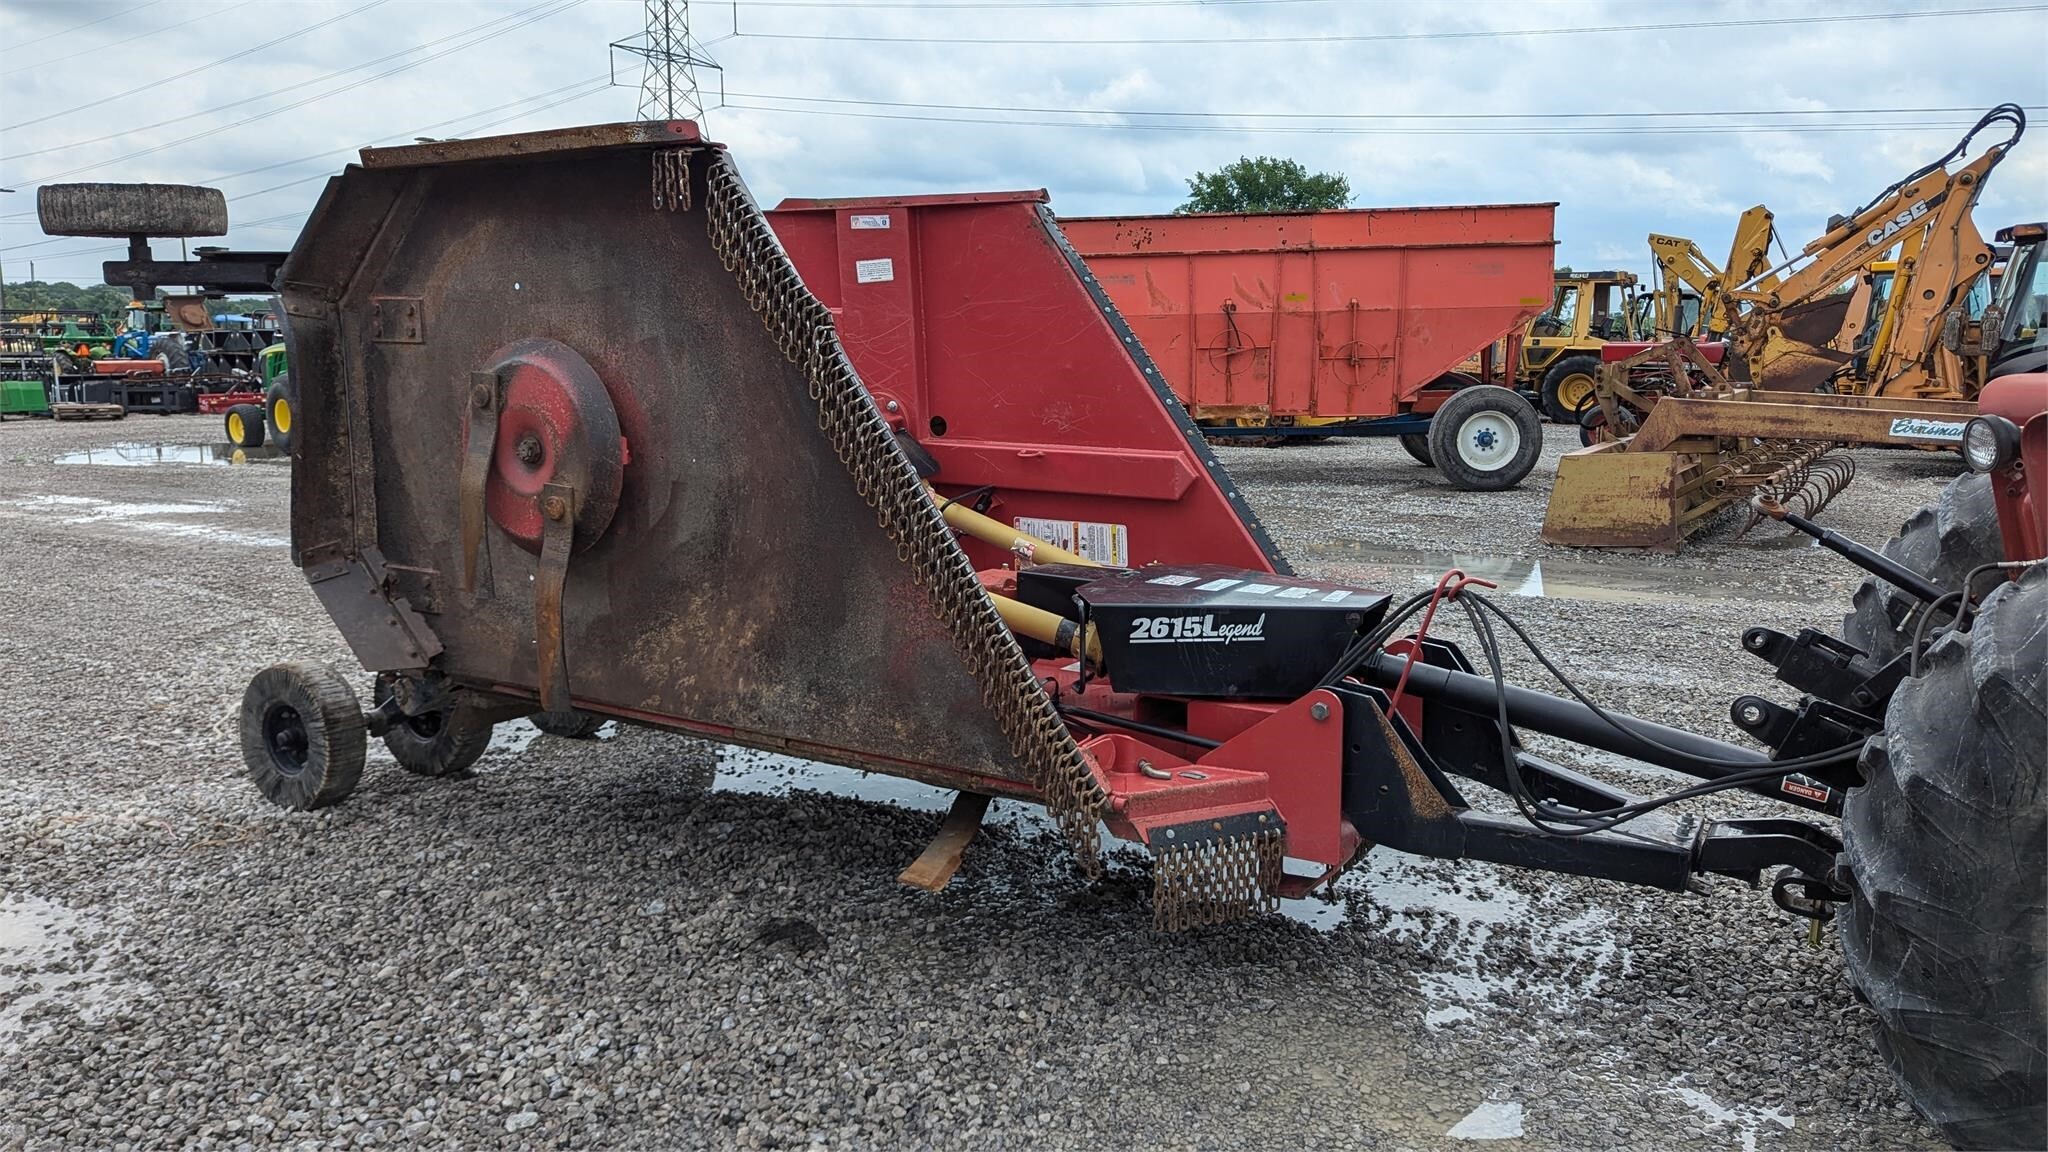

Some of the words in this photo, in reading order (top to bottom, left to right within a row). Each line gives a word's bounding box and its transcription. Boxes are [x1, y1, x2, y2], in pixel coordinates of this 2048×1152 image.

[1867, 199, 1928, 246] CASE
[1656, 237, 1681, 247] CAT
[1788, 784, 1813, 796] DANGER
